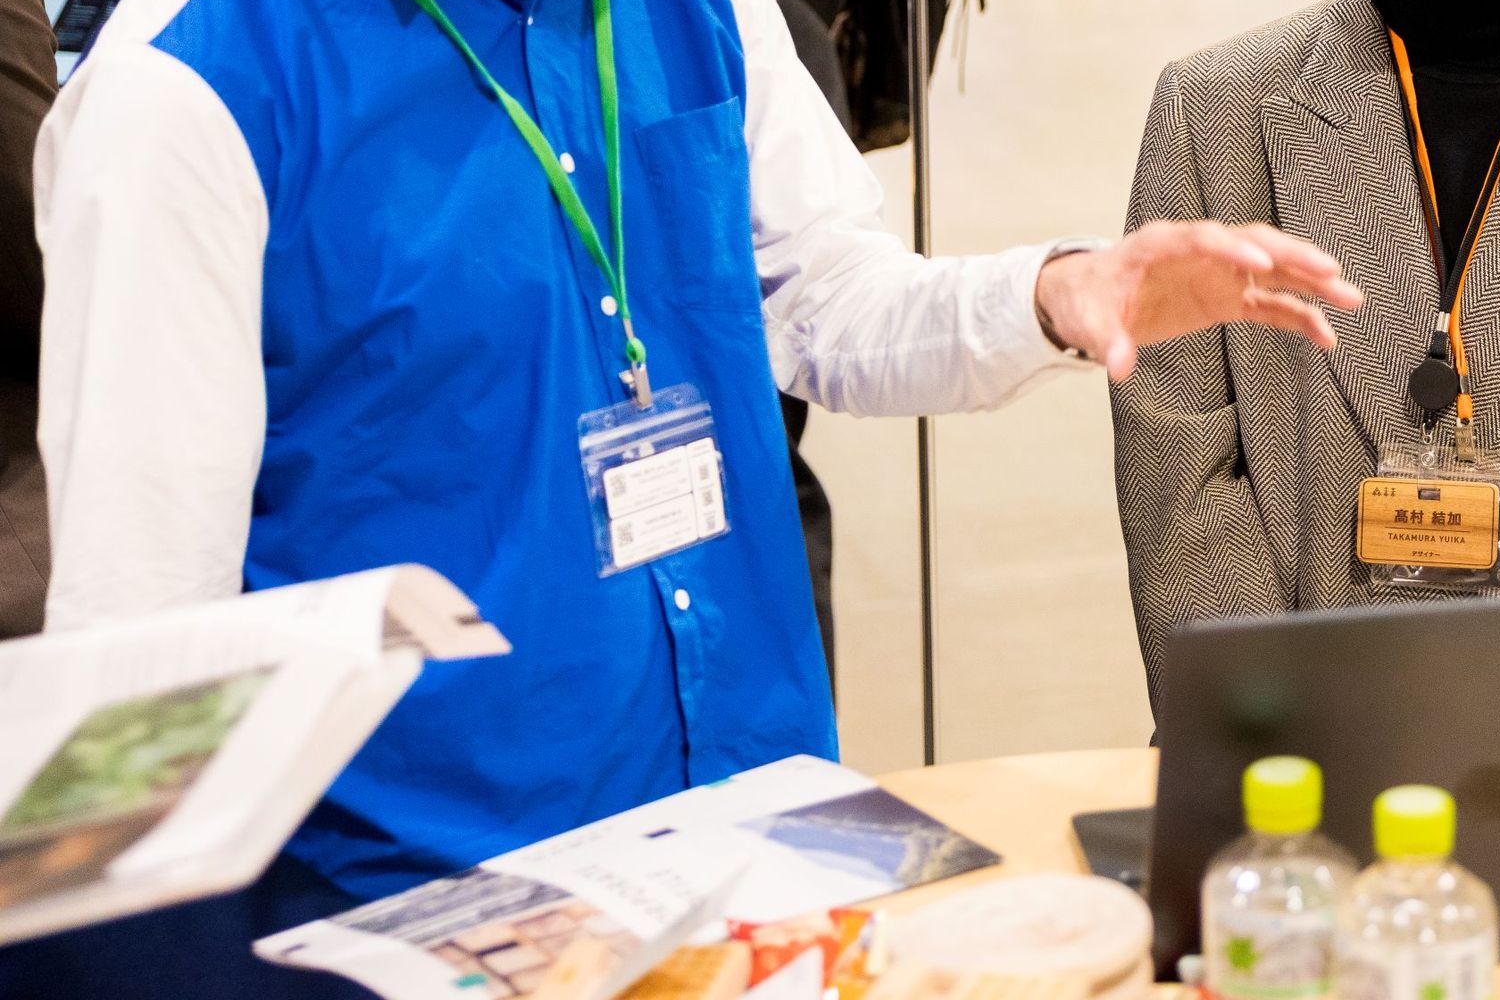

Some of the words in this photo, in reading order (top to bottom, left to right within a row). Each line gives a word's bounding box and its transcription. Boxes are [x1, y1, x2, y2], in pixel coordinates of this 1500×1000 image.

[1431, 511, 1462, 526] 結加
[1388, 532, 1436, 543] TAKAMURA
[1439, 535, 1466, 544] YUIKA
